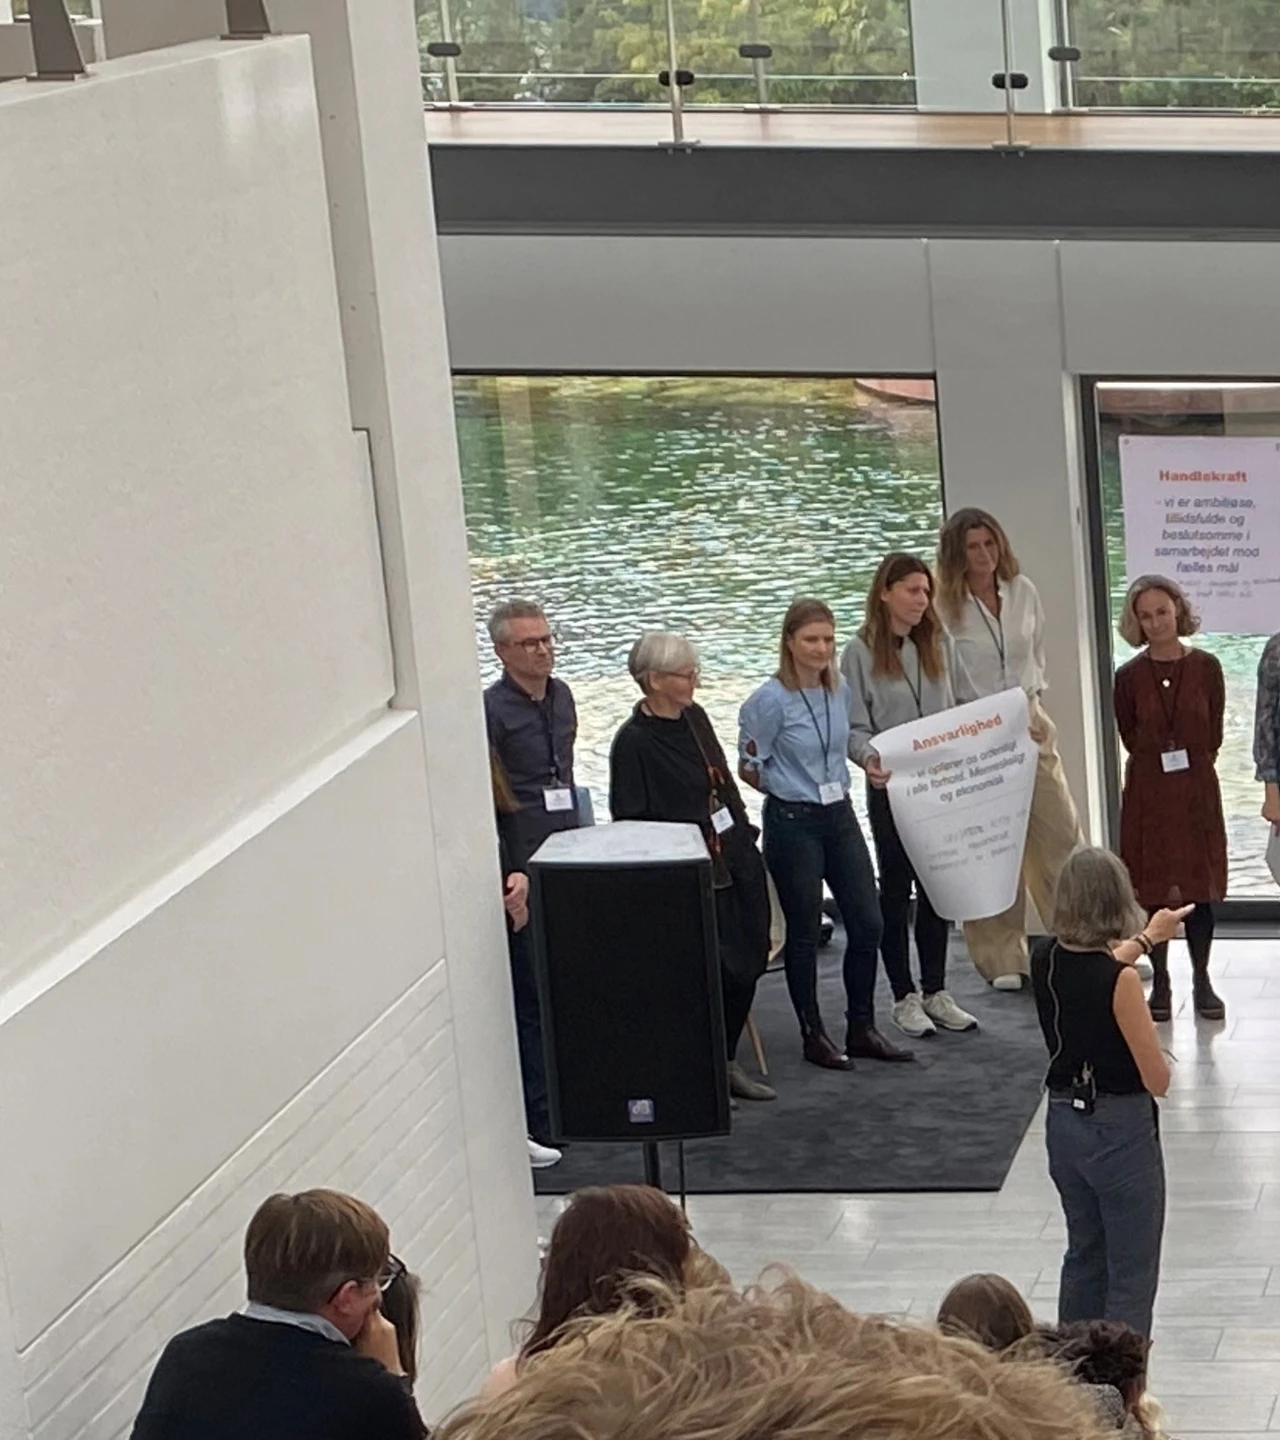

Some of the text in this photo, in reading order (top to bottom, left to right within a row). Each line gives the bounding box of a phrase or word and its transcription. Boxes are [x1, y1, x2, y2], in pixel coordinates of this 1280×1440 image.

[1164, 498, 1174, 507] vi
[1178, 499, 1190, 507] er
[1229, 515, 1245, 526] og
[1154, 546, 1259, 559] samarbejdet mod
[912, 713, 1002, 752] Ansvarlighed
[940, 792, 953, 802] og
